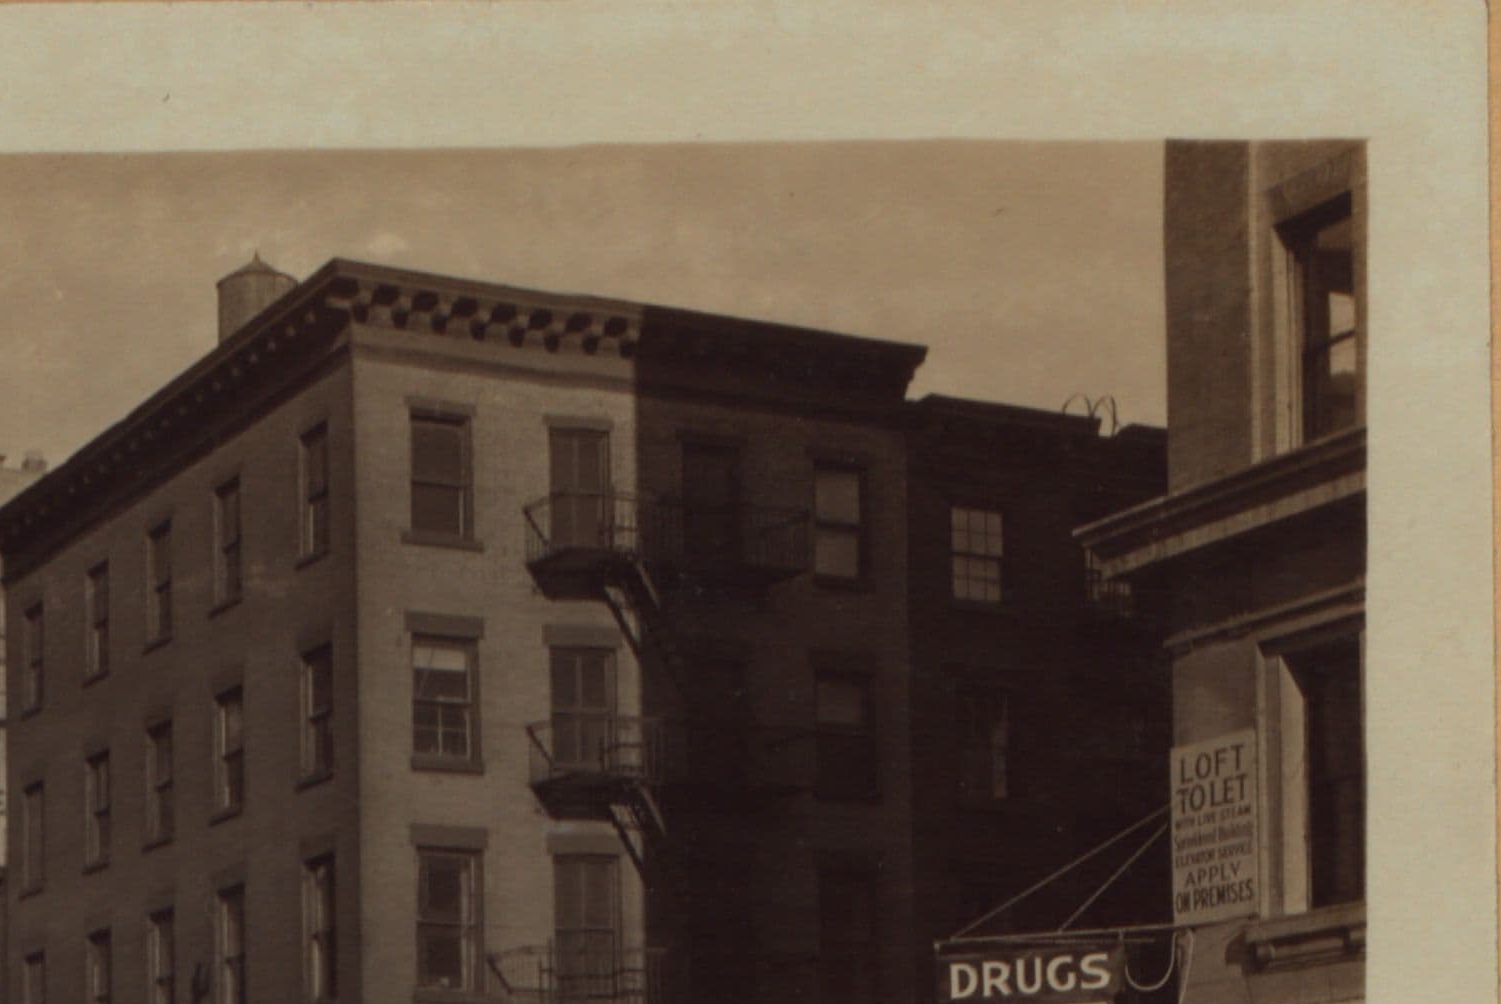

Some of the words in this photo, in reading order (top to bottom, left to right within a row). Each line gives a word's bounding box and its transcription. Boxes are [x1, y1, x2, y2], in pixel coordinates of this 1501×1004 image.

[1179, 743, 1245, 785] LOFT
[1175, 782, 1206, 814] TO
[1209, 773, 1249, 808] LET
[1219, 804, 1252, 821] STEAM
[1184, 861, 1242, 888] APPLY
[1175, 889, 1191, 915] ON
[1193, 877, 1255, 911] PREMISES
[949, 952, 1111, 999] DRUGS
